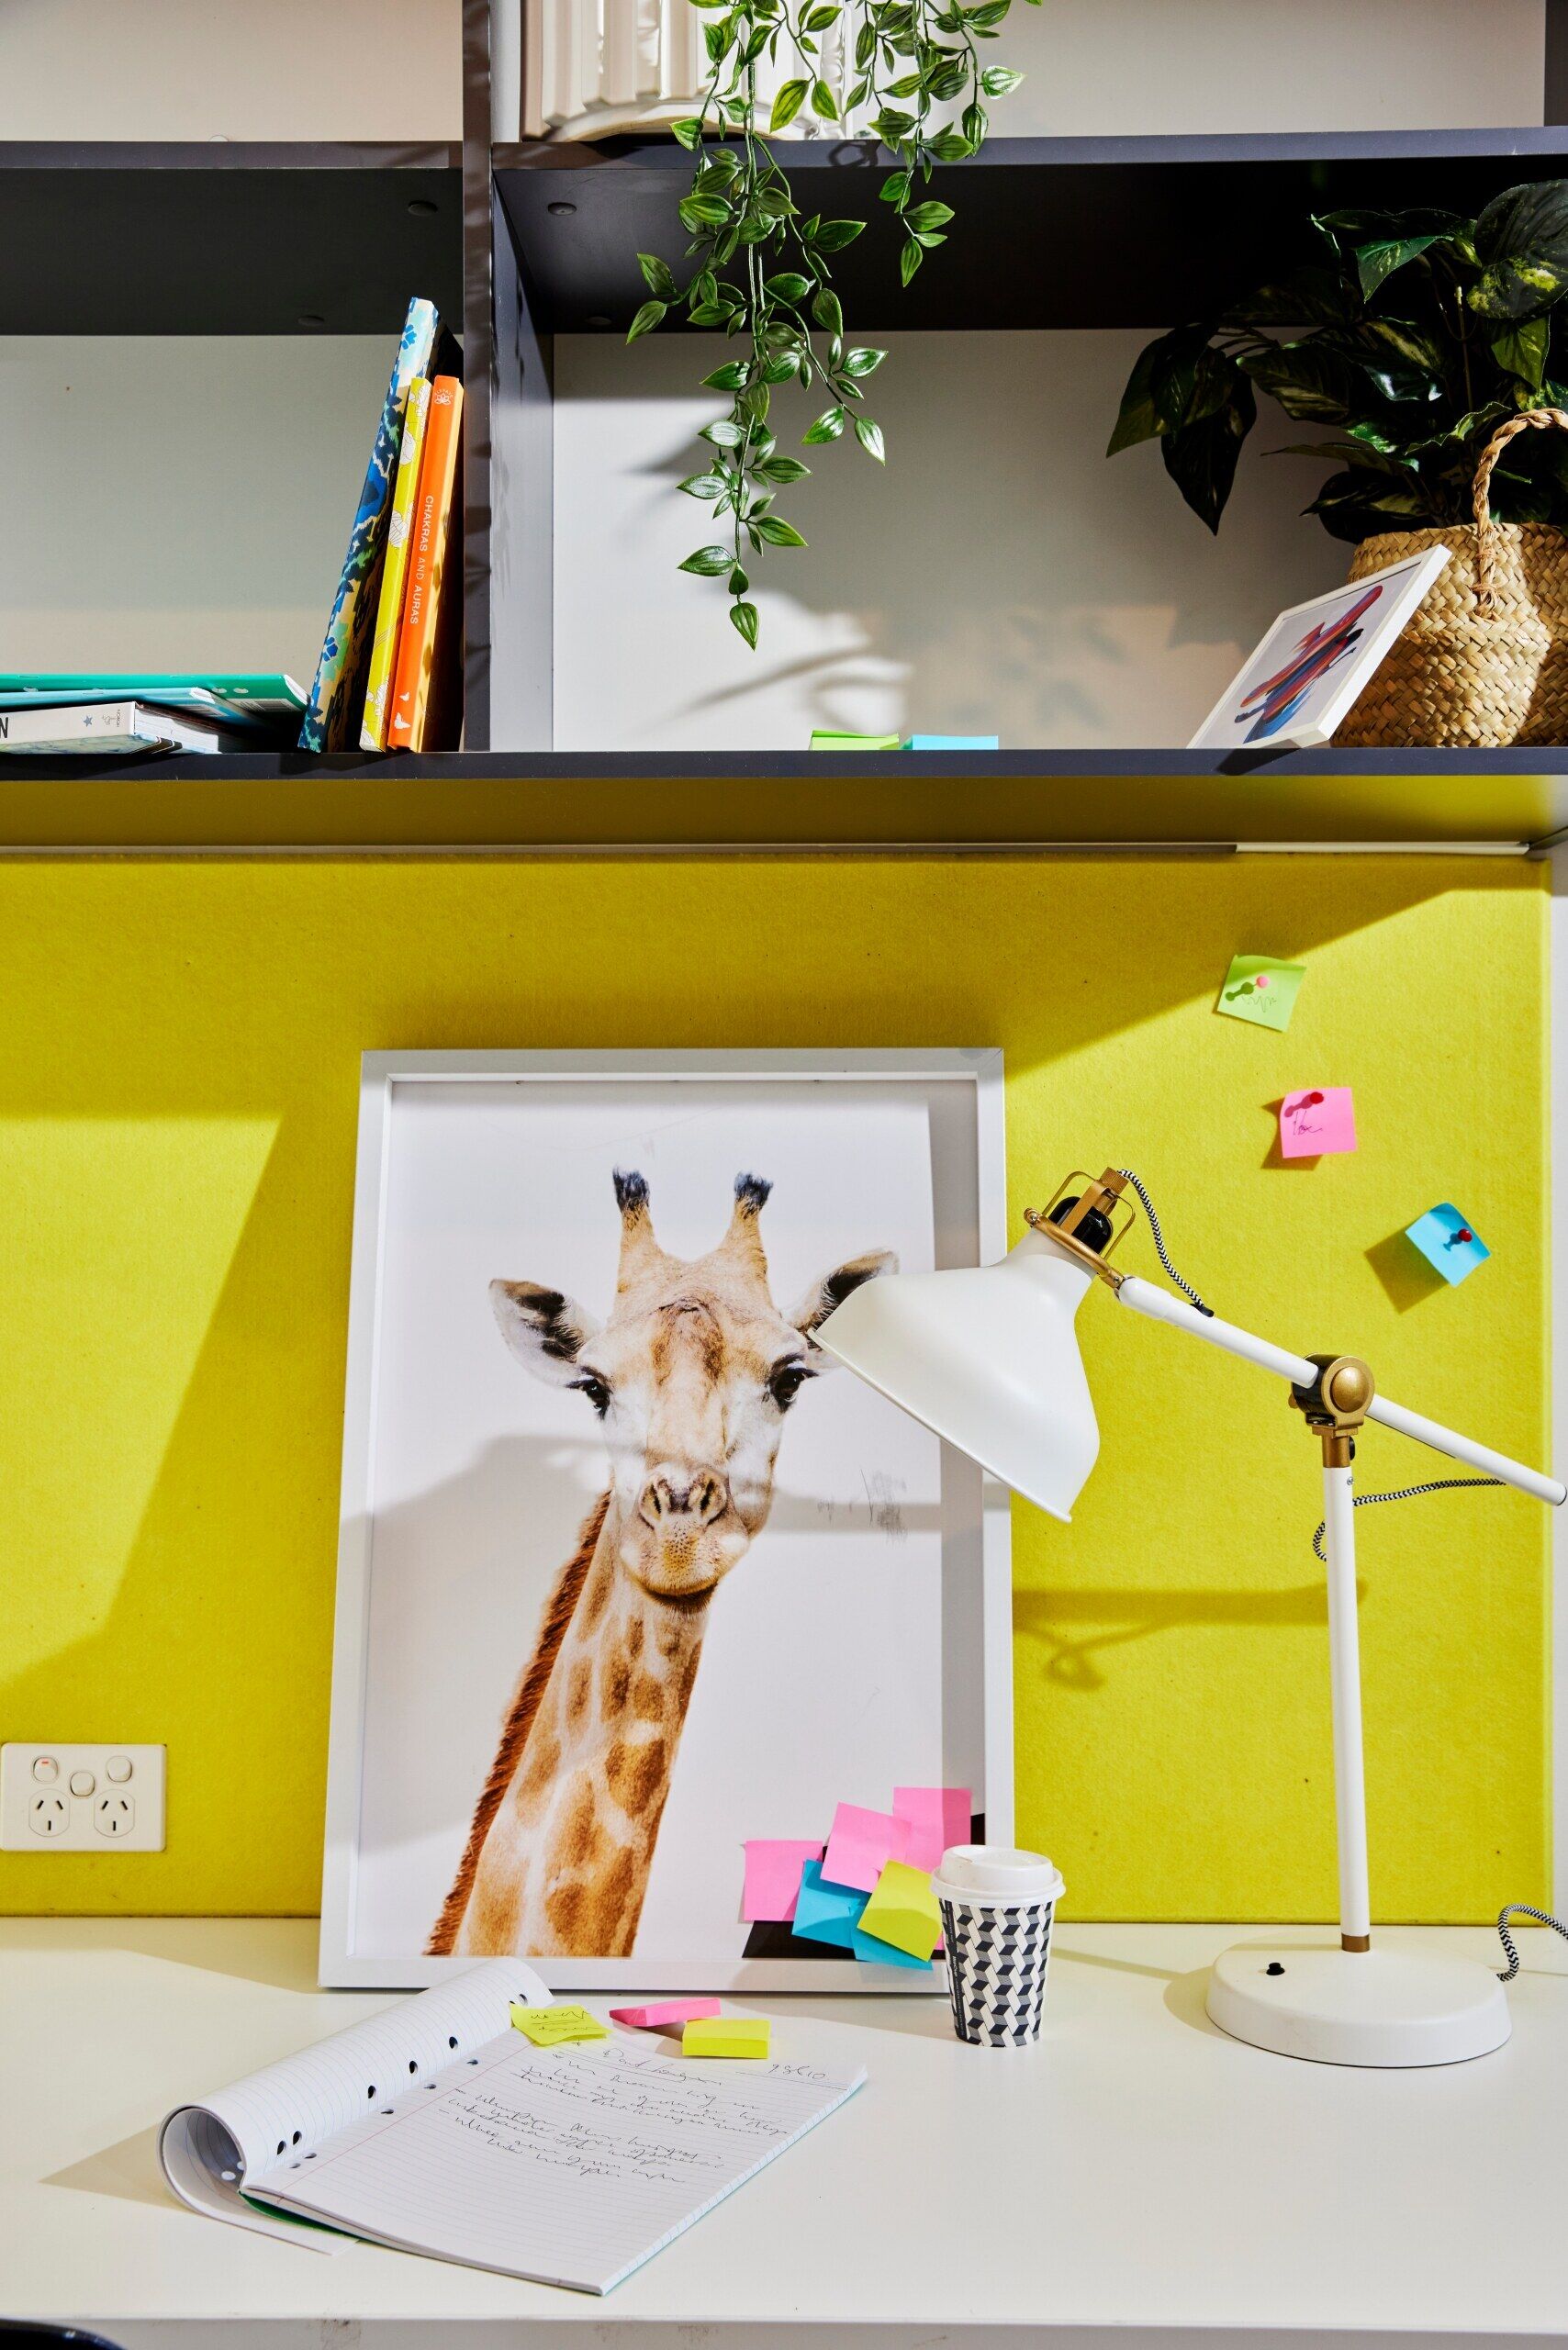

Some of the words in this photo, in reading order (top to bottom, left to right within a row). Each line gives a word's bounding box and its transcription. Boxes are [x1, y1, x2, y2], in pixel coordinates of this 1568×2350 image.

[420, 496, 433, 552] CHAKRAS
[416, 557, 426, 580] AND
[409, 585, 422, 624] AURAS
